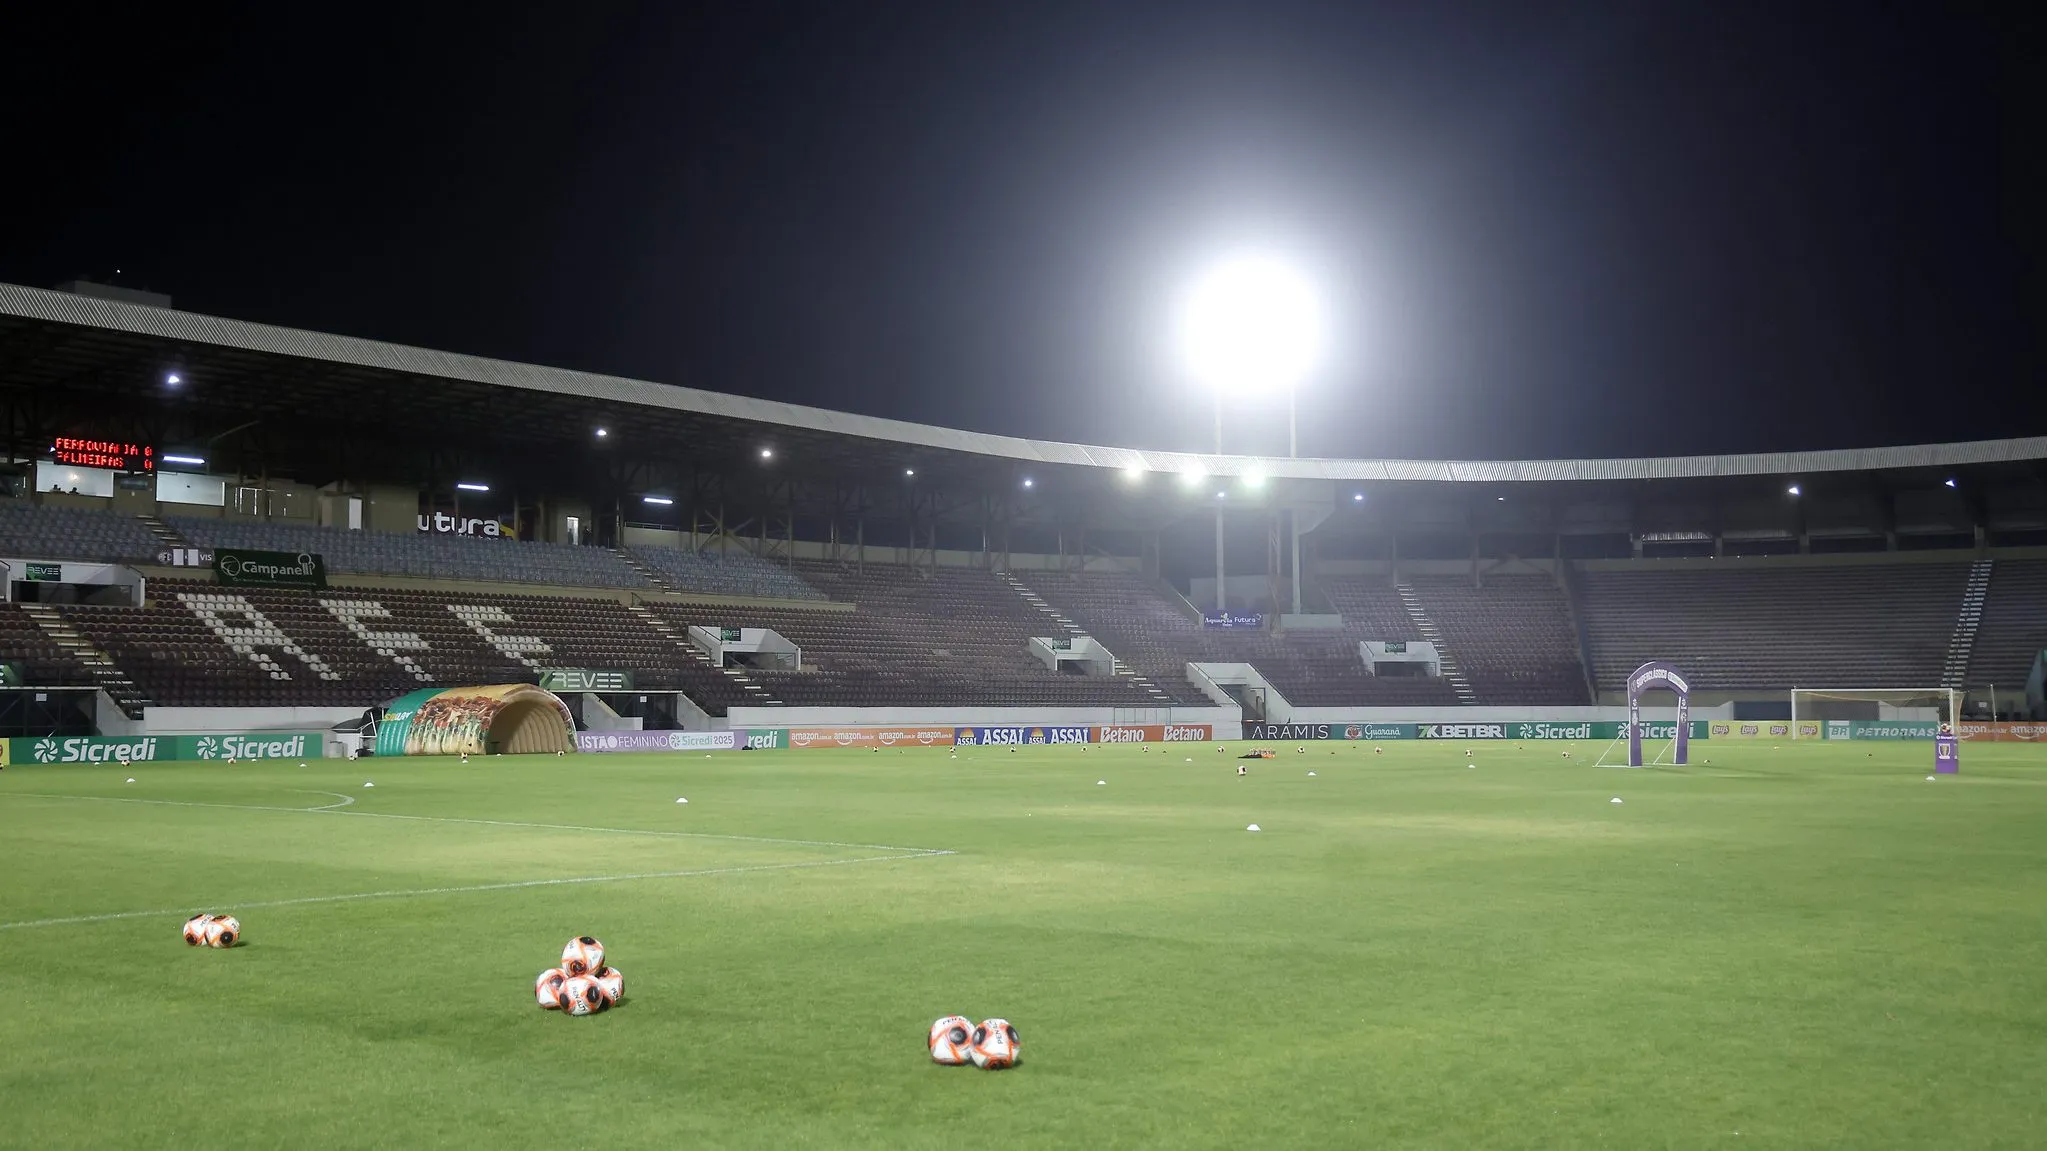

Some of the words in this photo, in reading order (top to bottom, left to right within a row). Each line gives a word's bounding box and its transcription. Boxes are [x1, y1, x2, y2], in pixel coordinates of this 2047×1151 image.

[241, 560, 315, 579] Campanelli
[1100, 726, 1145, 743] Betano
[1163, 725, 1205, 742] Betano
[1252, 725, 1329, 740] ARAMIS
[1534, 724, 1591, 739] Sicredi
[1639, 722, 1695, 738] Sicrei
[61, 738, 157, 762] Sicredi
[221, 735, 305, 758] Sicredi
[618, 735, 668, 748] FEMININO
[713, 735, 734, 745] 2025
